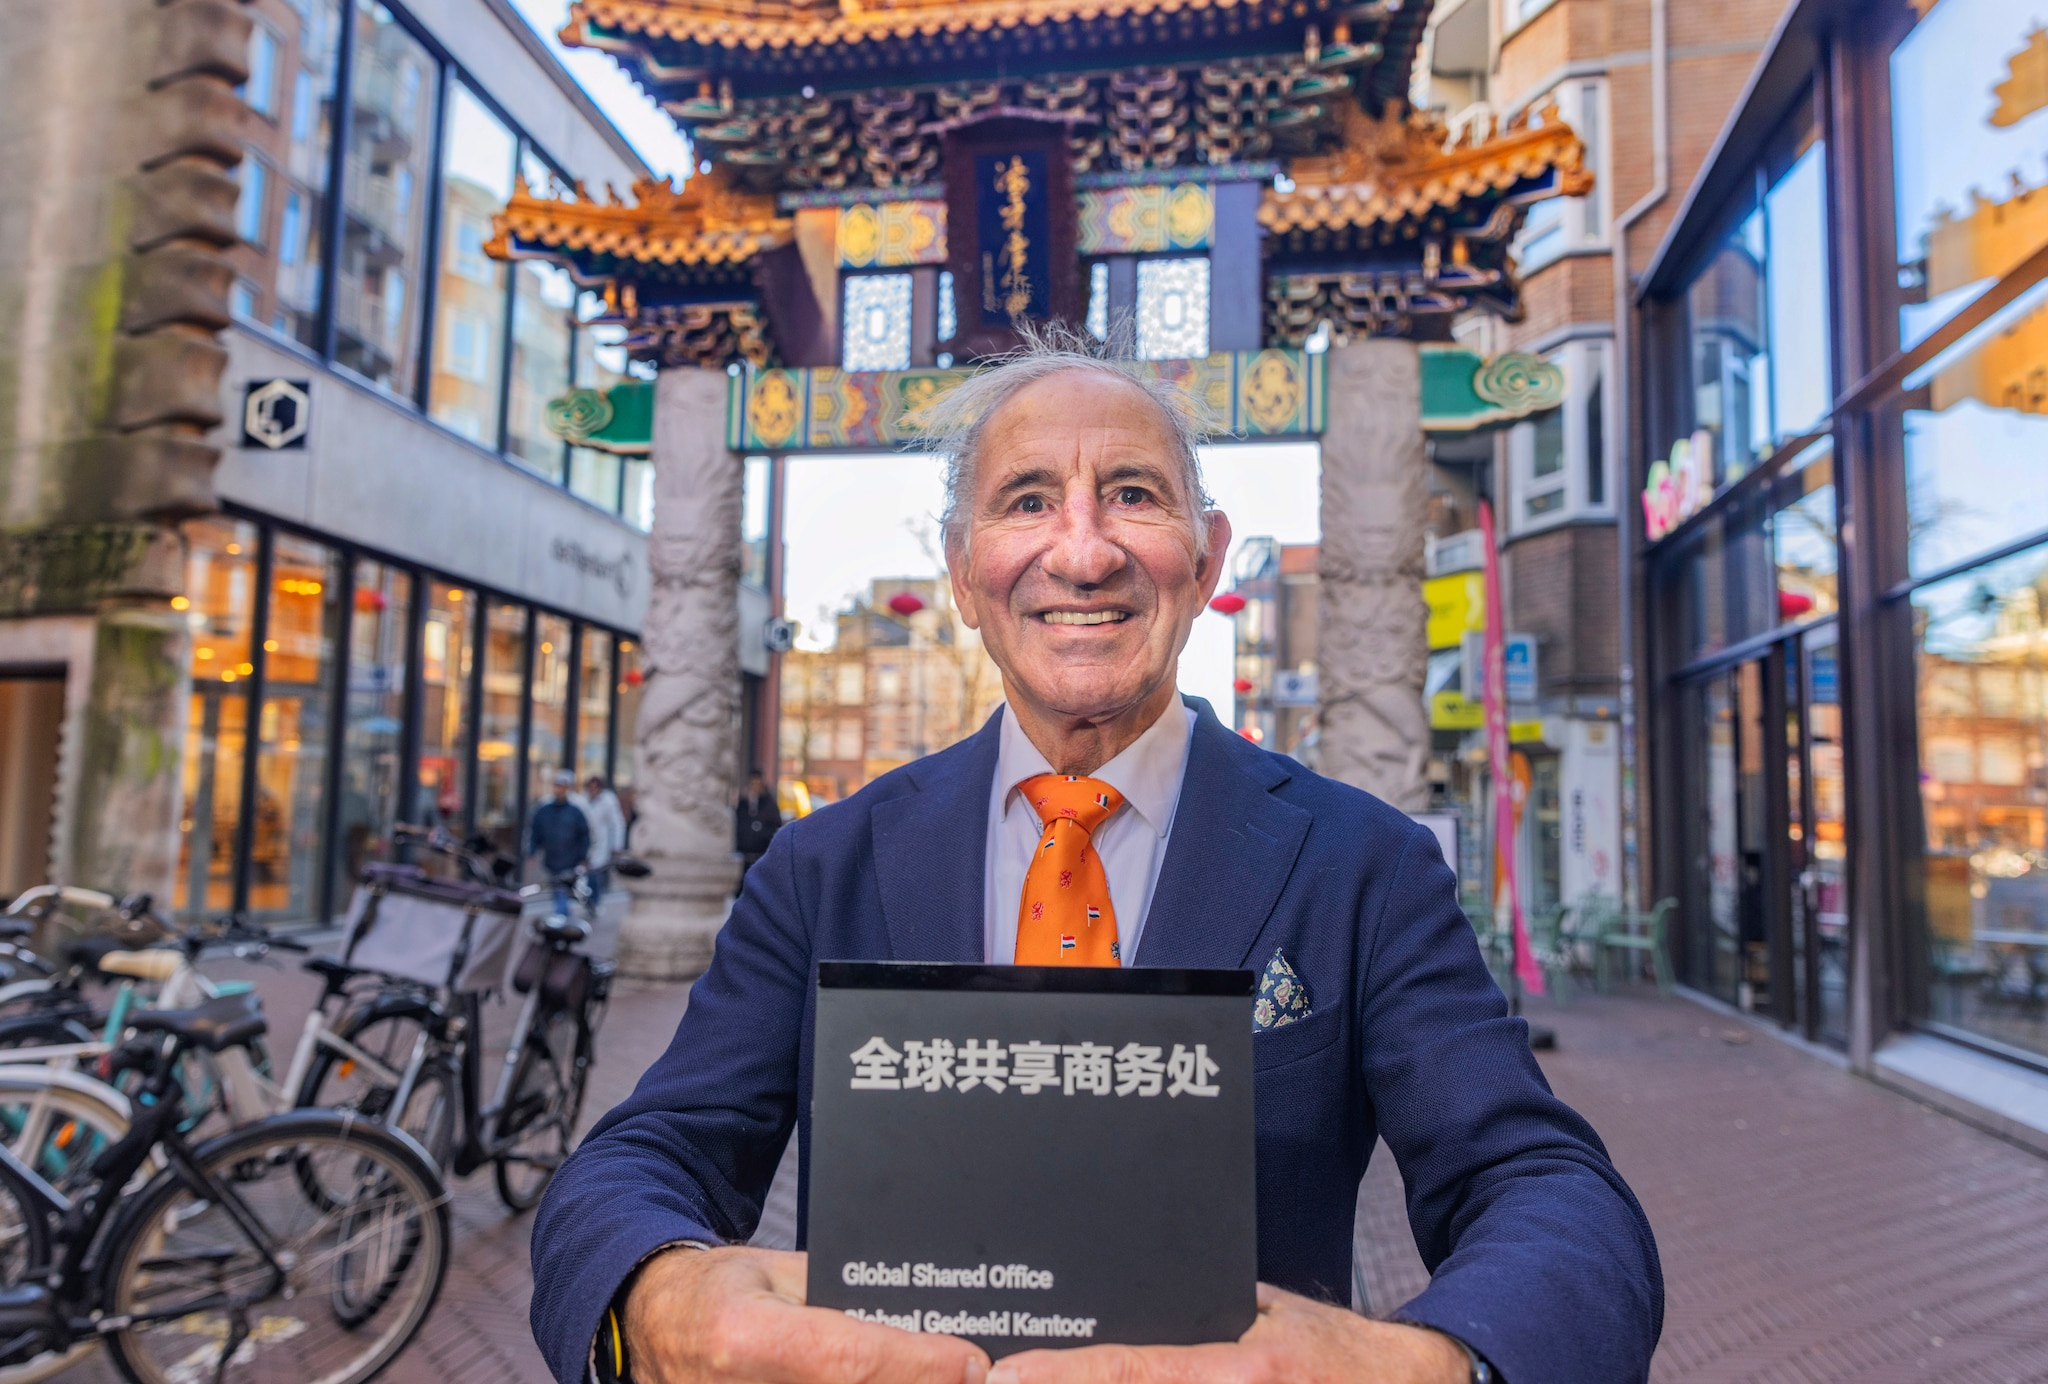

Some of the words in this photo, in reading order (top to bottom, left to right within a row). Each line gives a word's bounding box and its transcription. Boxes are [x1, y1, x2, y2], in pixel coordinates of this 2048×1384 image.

[850, 1036, 1220, 1098] 全球共享商务处
[842, 1261, 910, 1286] Global
[912, 1263, 987, 1288] Shared
[989, 1264, 1054, 1290] Office
[923, 1310, 1010, 1336] Gedeeld
[1012, 1312, 1097, 1338] Kantoor
